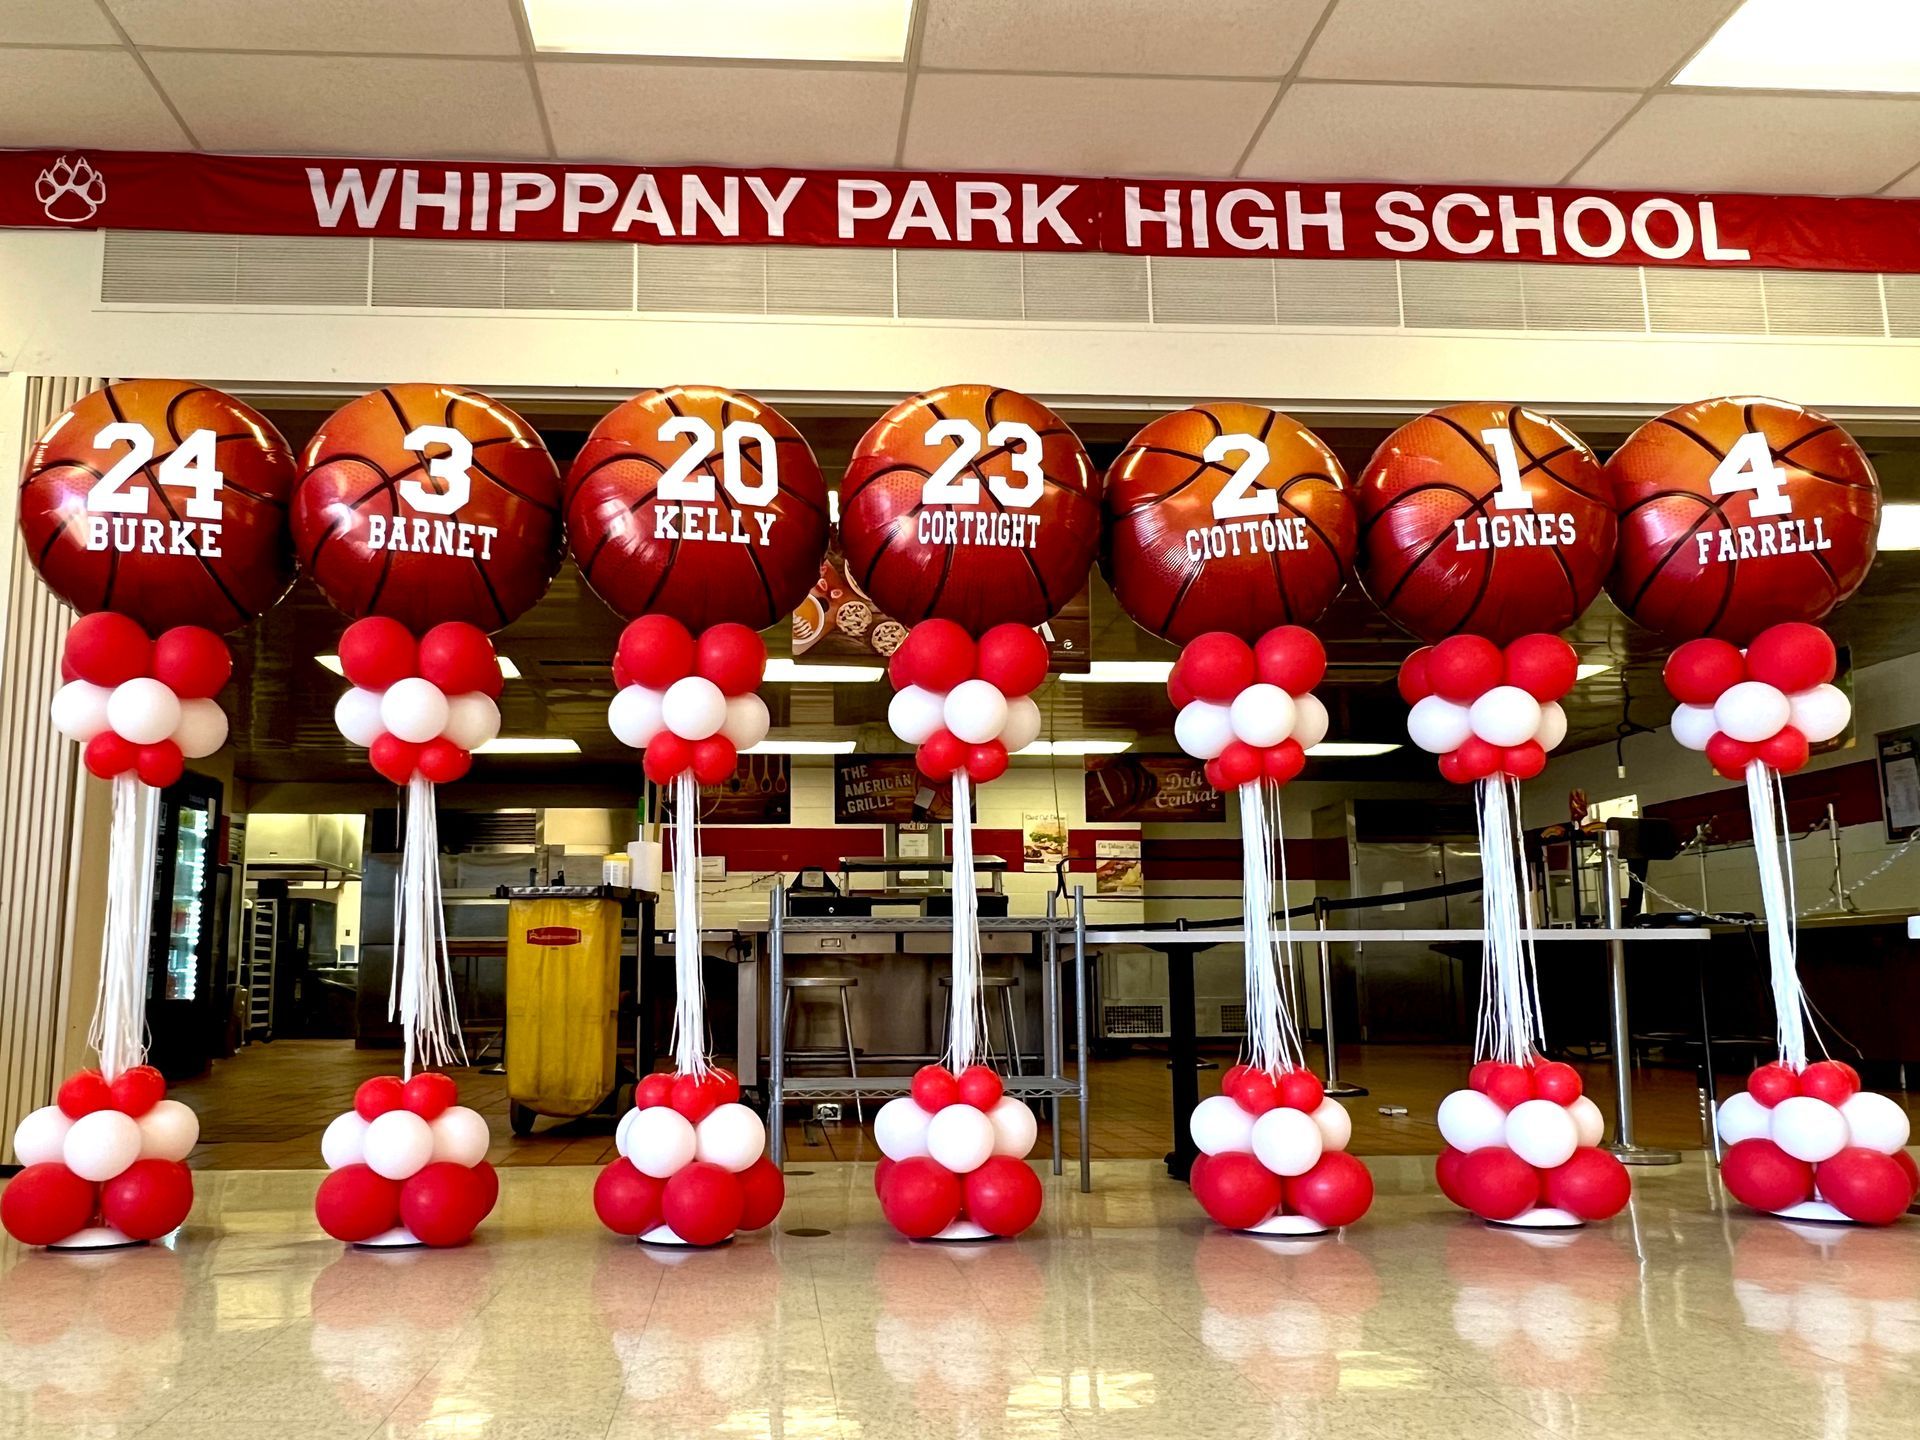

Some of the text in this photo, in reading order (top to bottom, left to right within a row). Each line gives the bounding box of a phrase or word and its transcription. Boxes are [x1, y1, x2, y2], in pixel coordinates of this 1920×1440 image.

[305, 167, 1752, 262] WHIPPANY PARK HIGH SCHOOL
[87, 422, 224, 520] 24
[400, 426, 472, 514] 3
[658, 417, 778, 506] 20
[923, 420, 1043, 507] 23
[1204, 434, 1278, 519] 2
[1482, 429, 1532, 509] 1
[1710, 433, 1791, 517] 4
[87, 515, 223, 558] BURKE
[368, 515, 497, 559] BARNET
[655, 502, 775, 545] KELLY
[919, 511, 1040, 547] CORTRIGHT
[1185, 517, 1309, 562] CIOTTONE
[1455, 514, 1575, 550] LIGNES
[1696, 518, 1830, 564] FARRELL
[841, 765, 868, 781] THE
[846, 774, 912, 797] AMERICAN
[1166, 771, 1203, 790] Deli
[847, 795, 894, 814] GRILLE
